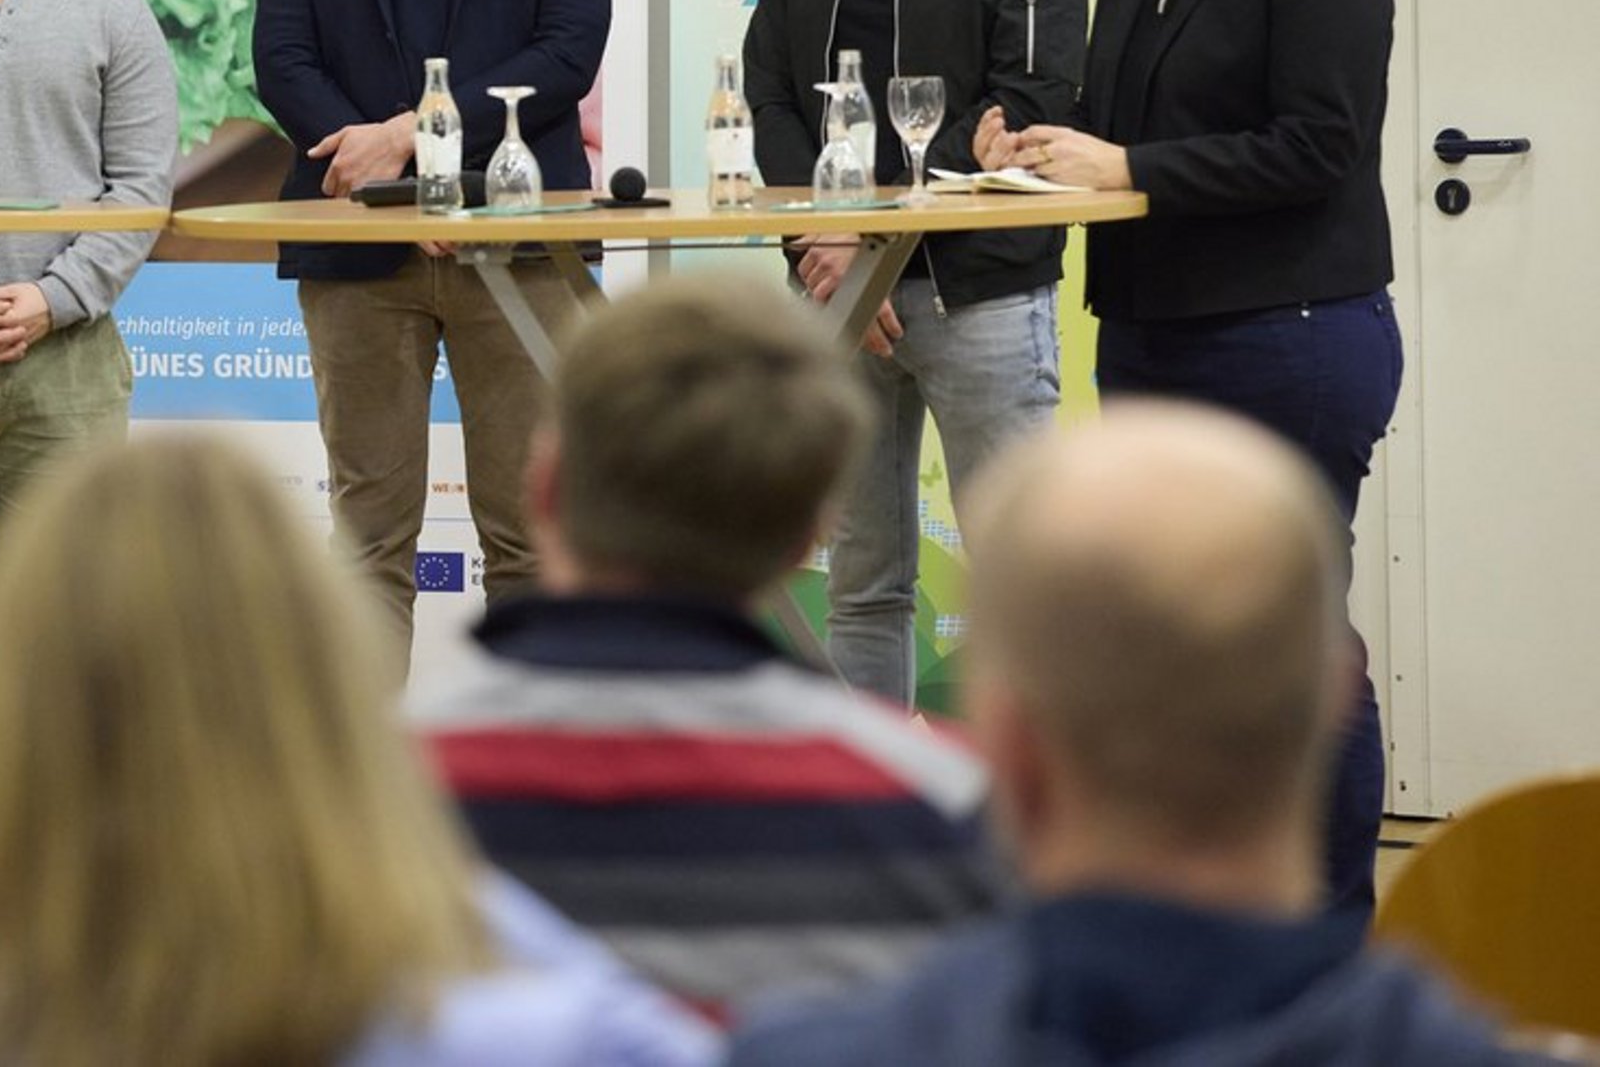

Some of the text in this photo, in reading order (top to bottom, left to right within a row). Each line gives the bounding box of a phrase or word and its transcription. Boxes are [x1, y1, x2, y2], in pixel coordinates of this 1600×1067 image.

[117, 317, 230, 340] chhaltigkeit
[238, 317, 255, 336] in
[131, 345, 314, 379] ÜNES GRÜND
